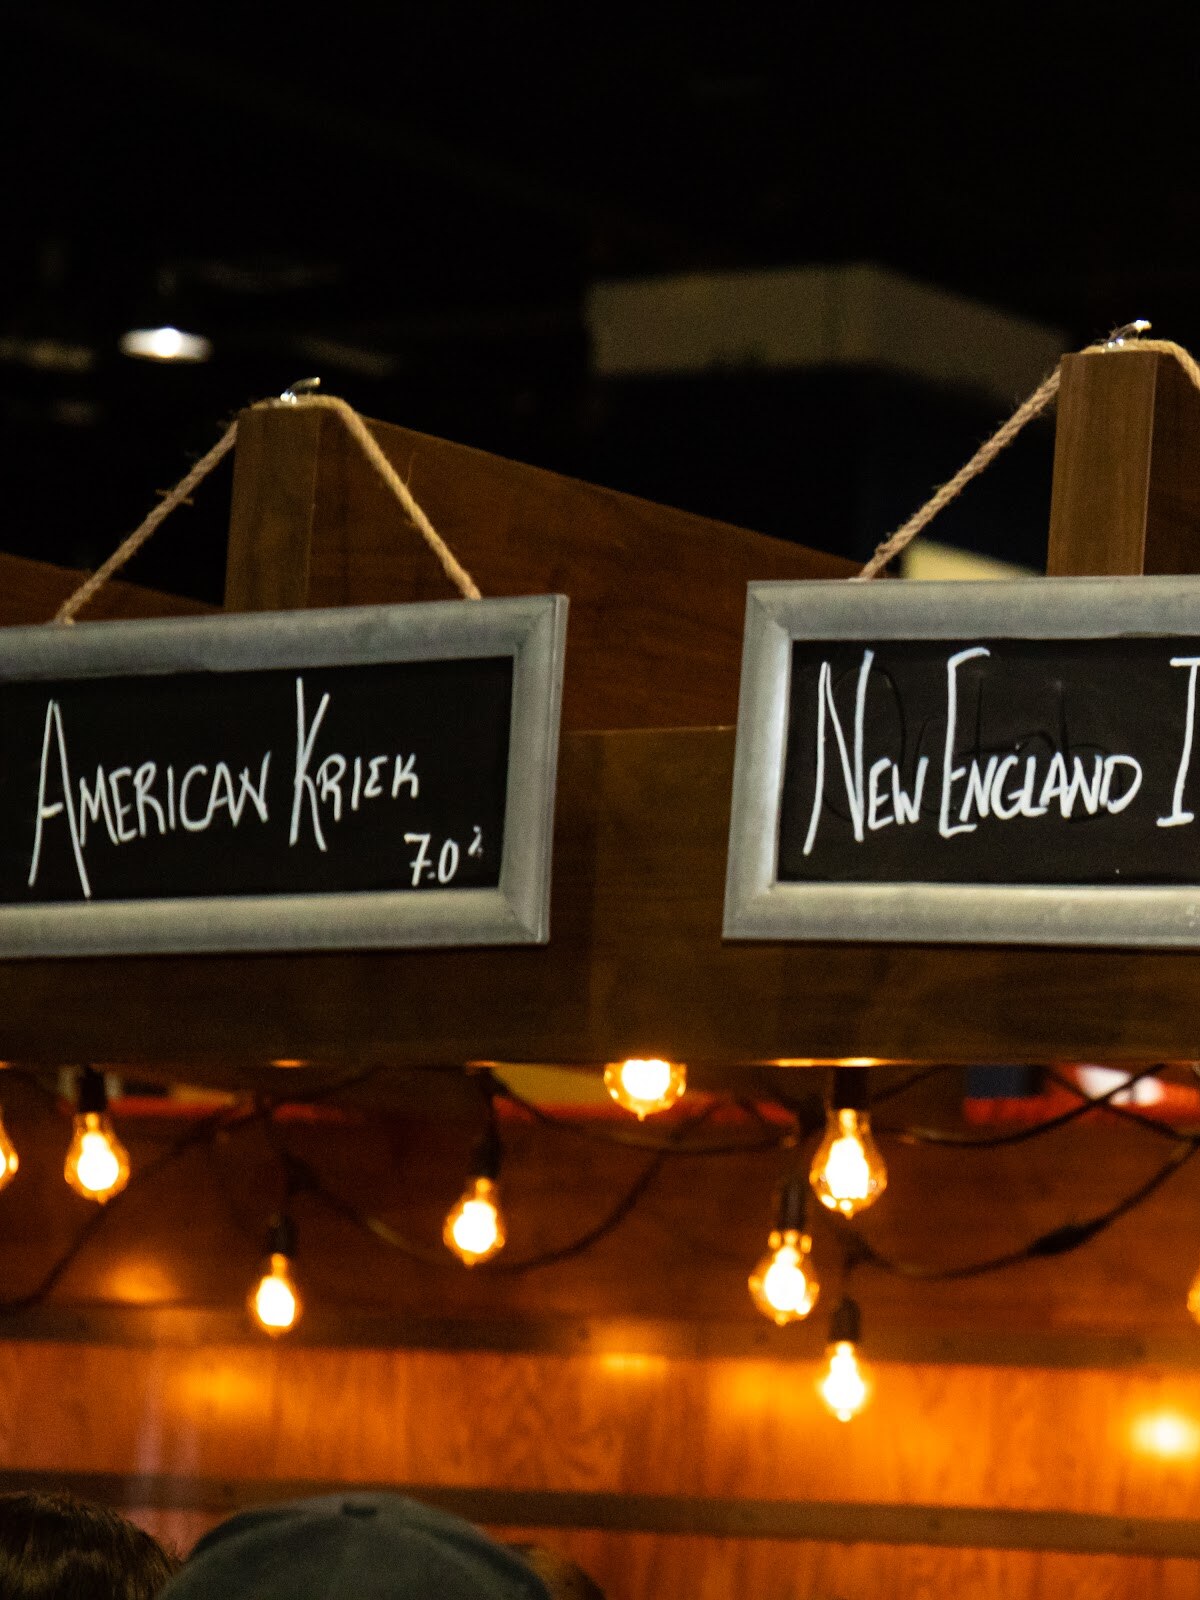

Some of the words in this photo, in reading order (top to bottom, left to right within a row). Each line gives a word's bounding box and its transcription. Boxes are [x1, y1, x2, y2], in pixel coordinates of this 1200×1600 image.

[27, 698, 272, 899] AMERICAN
[801, 649, 931, 857] NEW
[936, 646, 1144, 840] ENGLAND
[403, 824, 484, 888] 7.0%
